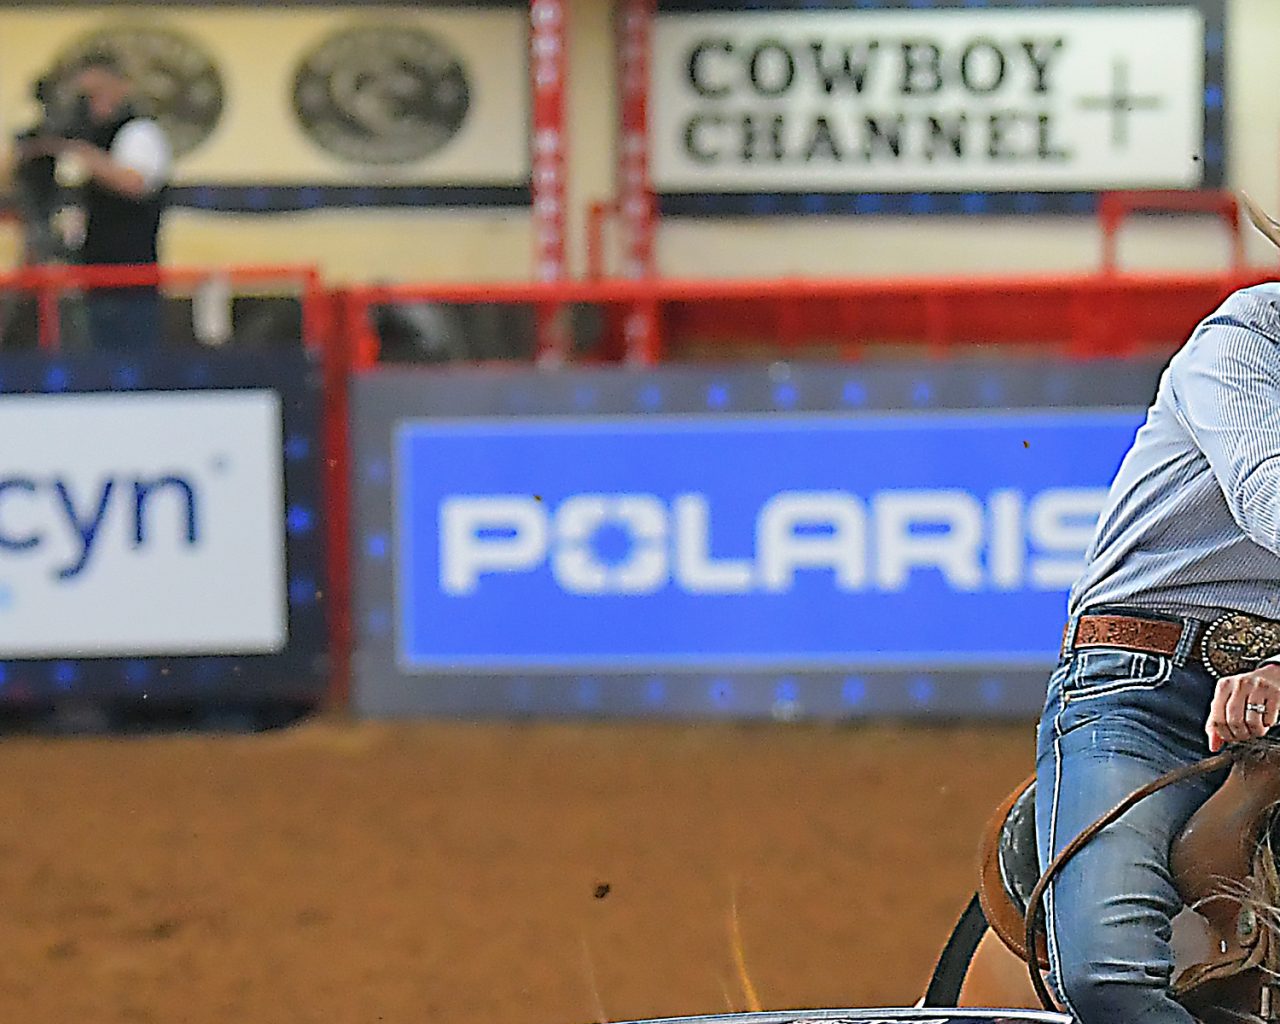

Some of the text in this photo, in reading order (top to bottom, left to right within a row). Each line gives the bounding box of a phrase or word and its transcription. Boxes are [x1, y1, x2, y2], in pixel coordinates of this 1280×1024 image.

[685, 37, 1065, 97] COWBOY
[683, 112, 1073, 163] CHANNEL
[438, 487, 1108, 598] POLARIS
